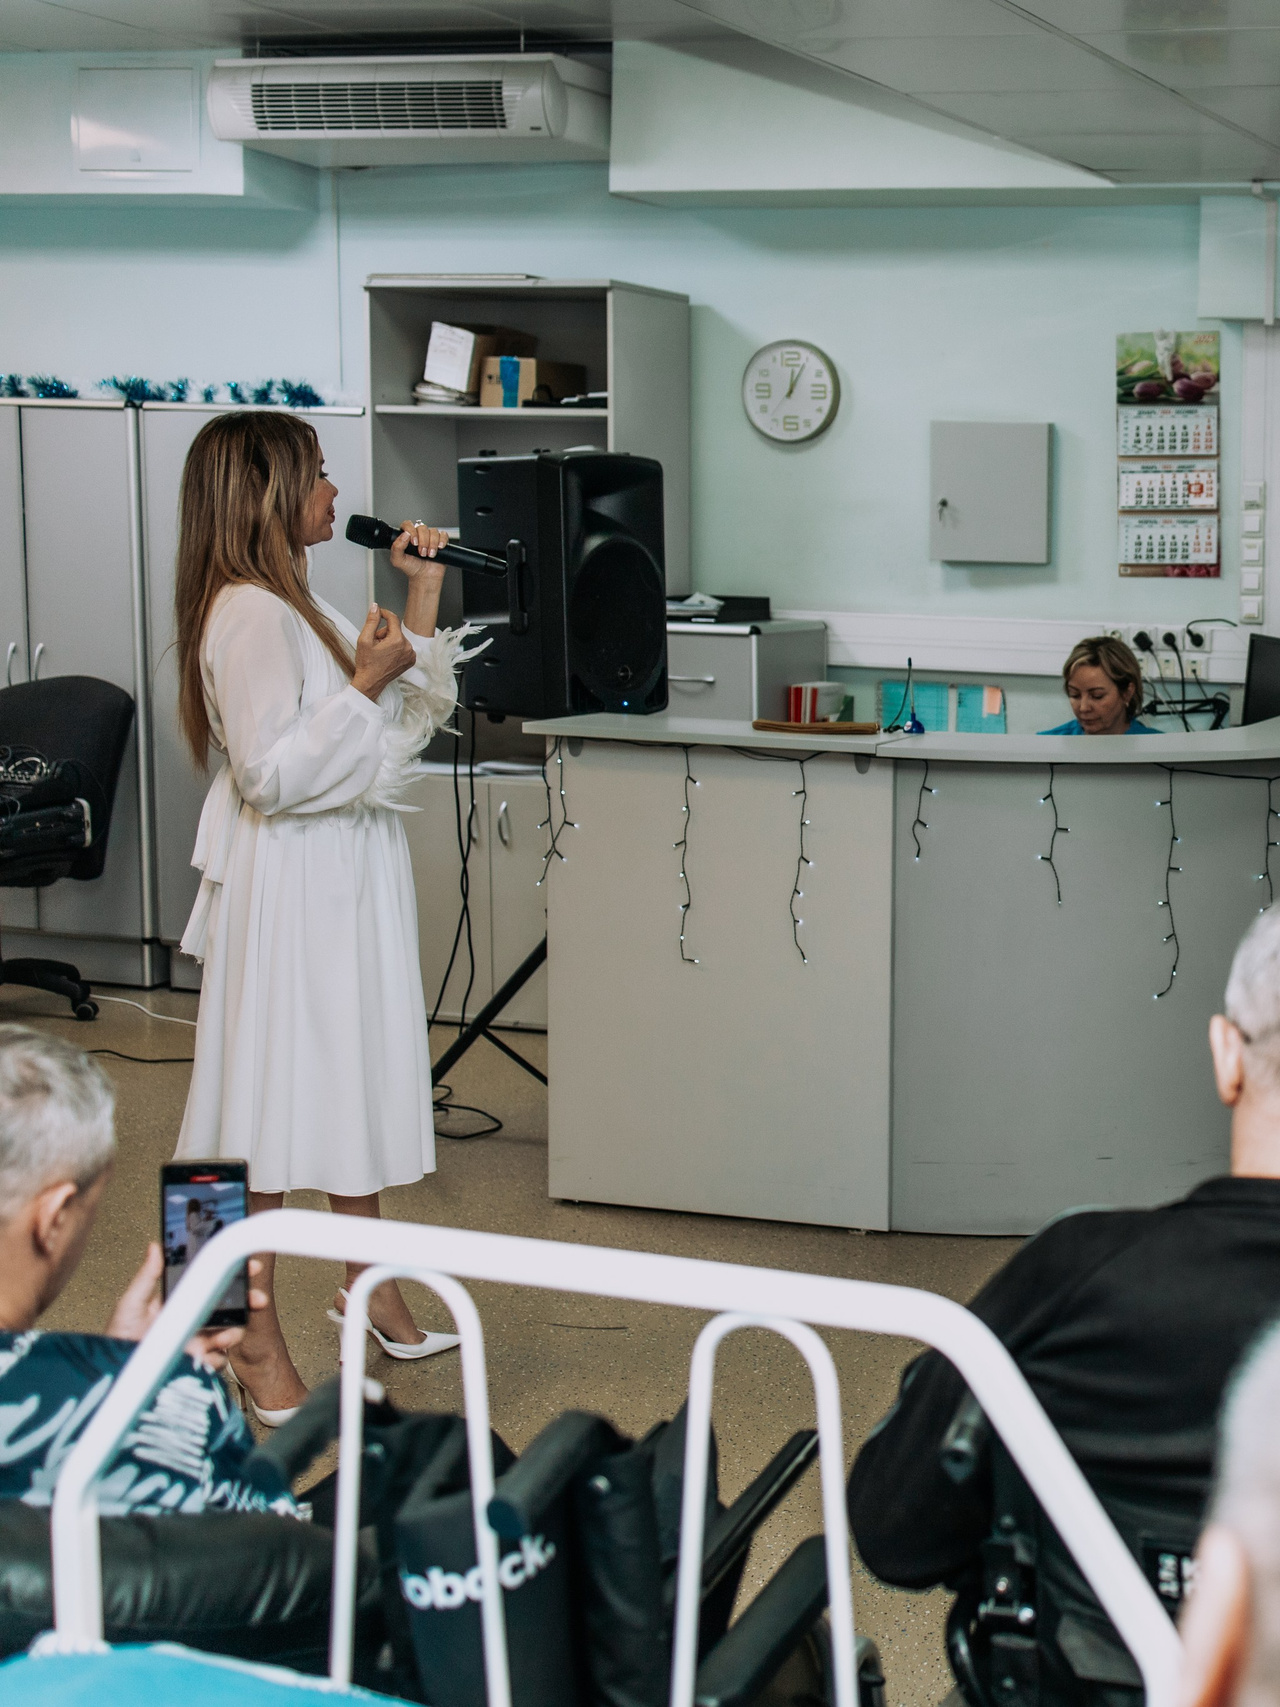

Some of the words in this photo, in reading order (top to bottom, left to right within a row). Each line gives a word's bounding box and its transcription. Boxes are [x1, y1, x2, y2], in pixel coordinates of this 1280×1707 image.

[781, 351, 800, 367] 12
[755, 383, 771, 399] 9
[811, 384, 827, 399] 3
[783, 415, 799, 431] 6
